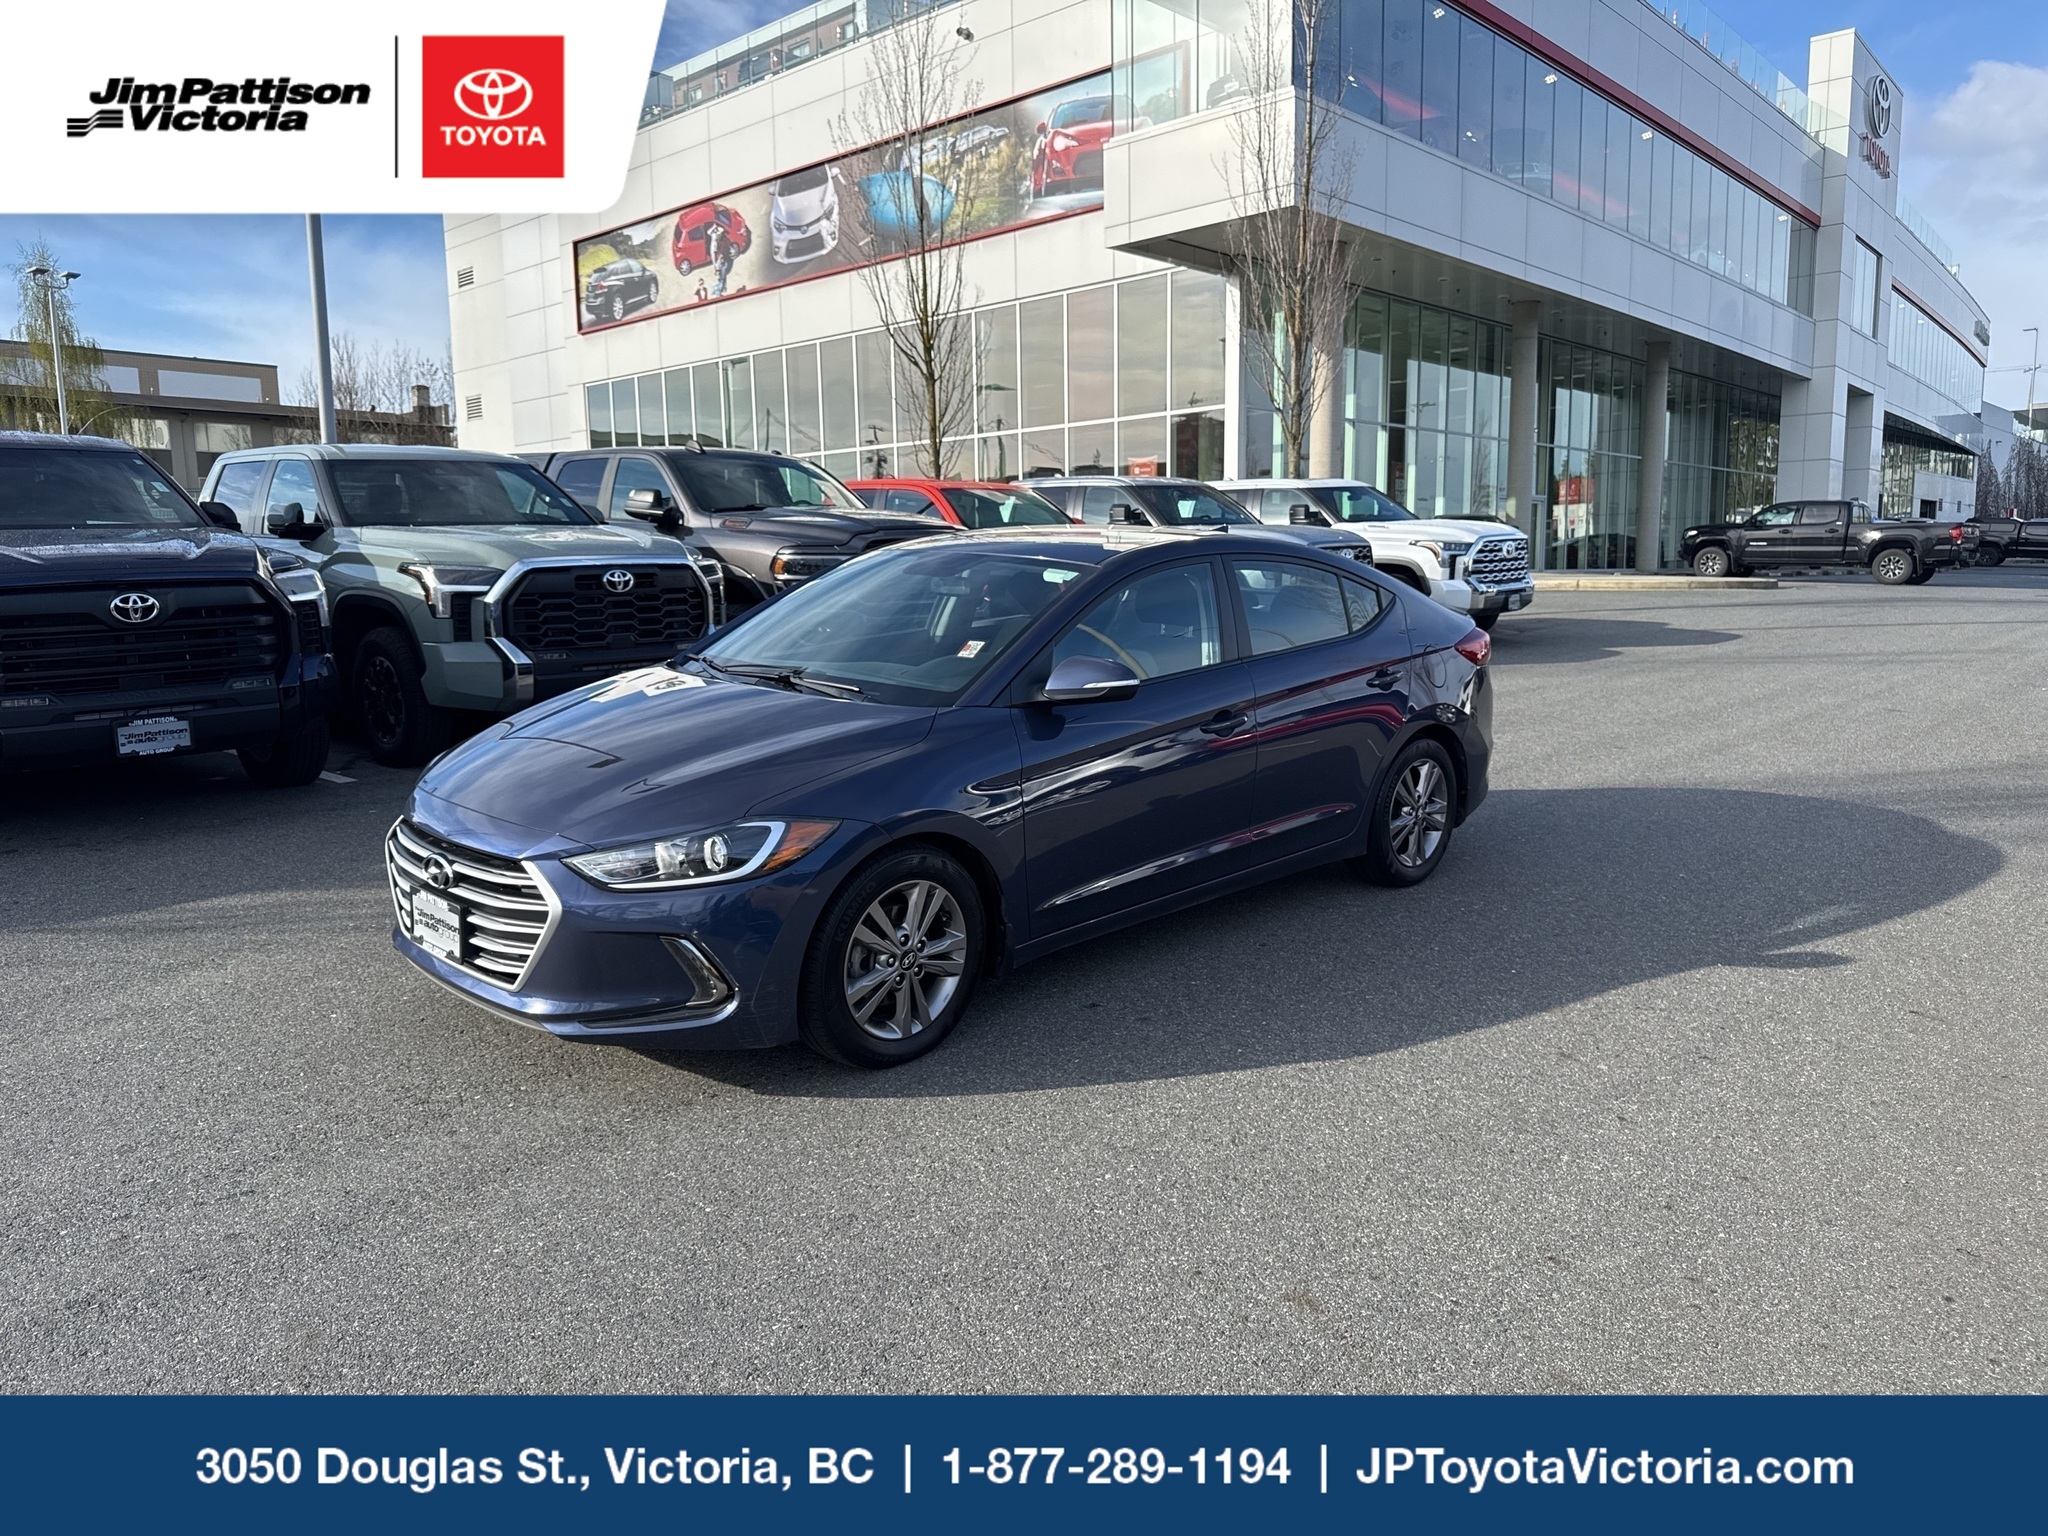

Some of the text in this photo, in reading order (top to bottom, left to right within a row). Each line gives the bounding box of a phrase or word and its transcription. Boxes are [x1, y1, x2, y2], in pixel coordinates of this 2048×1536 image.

[1861, 131, 1890, 177] TOYOTA
[131, 716, 175, 727] JIM PATTISON
